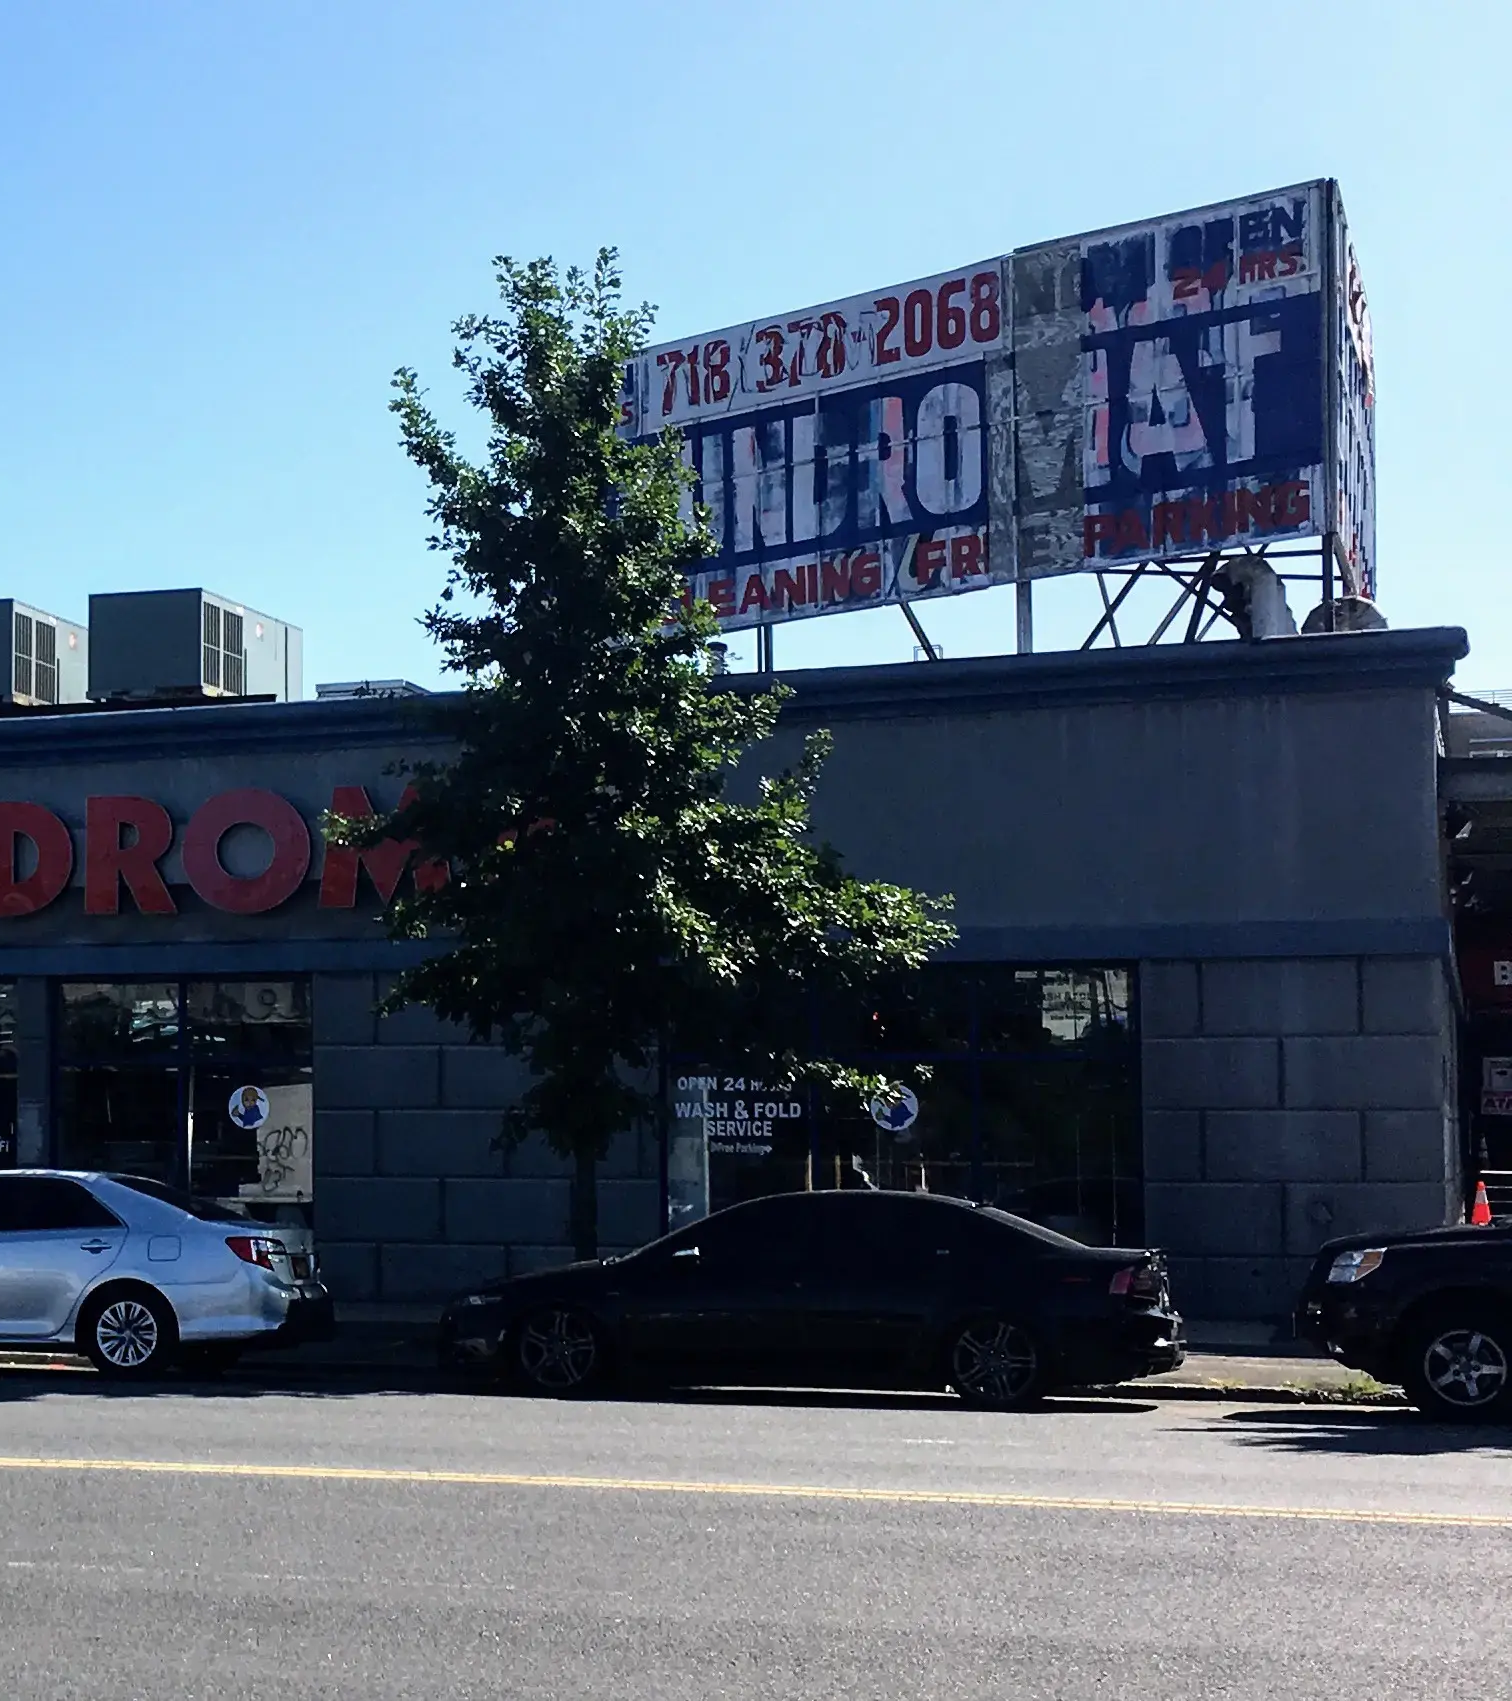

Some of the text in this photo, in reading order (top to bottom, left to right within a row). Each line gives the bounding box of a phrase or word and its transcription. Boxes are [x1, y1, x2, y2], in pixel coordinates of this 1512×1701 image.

[656, 338, 731, 417] 718
[1084, 481, 1311, 558] PARKING
[677, 1077, 717, 1091] OPEN
[723, 1077, 745, 1091] 24
[675, 1099, 802, 1120] WASH & FOLD
[706, 1120, 774, 1137] SERVICE
